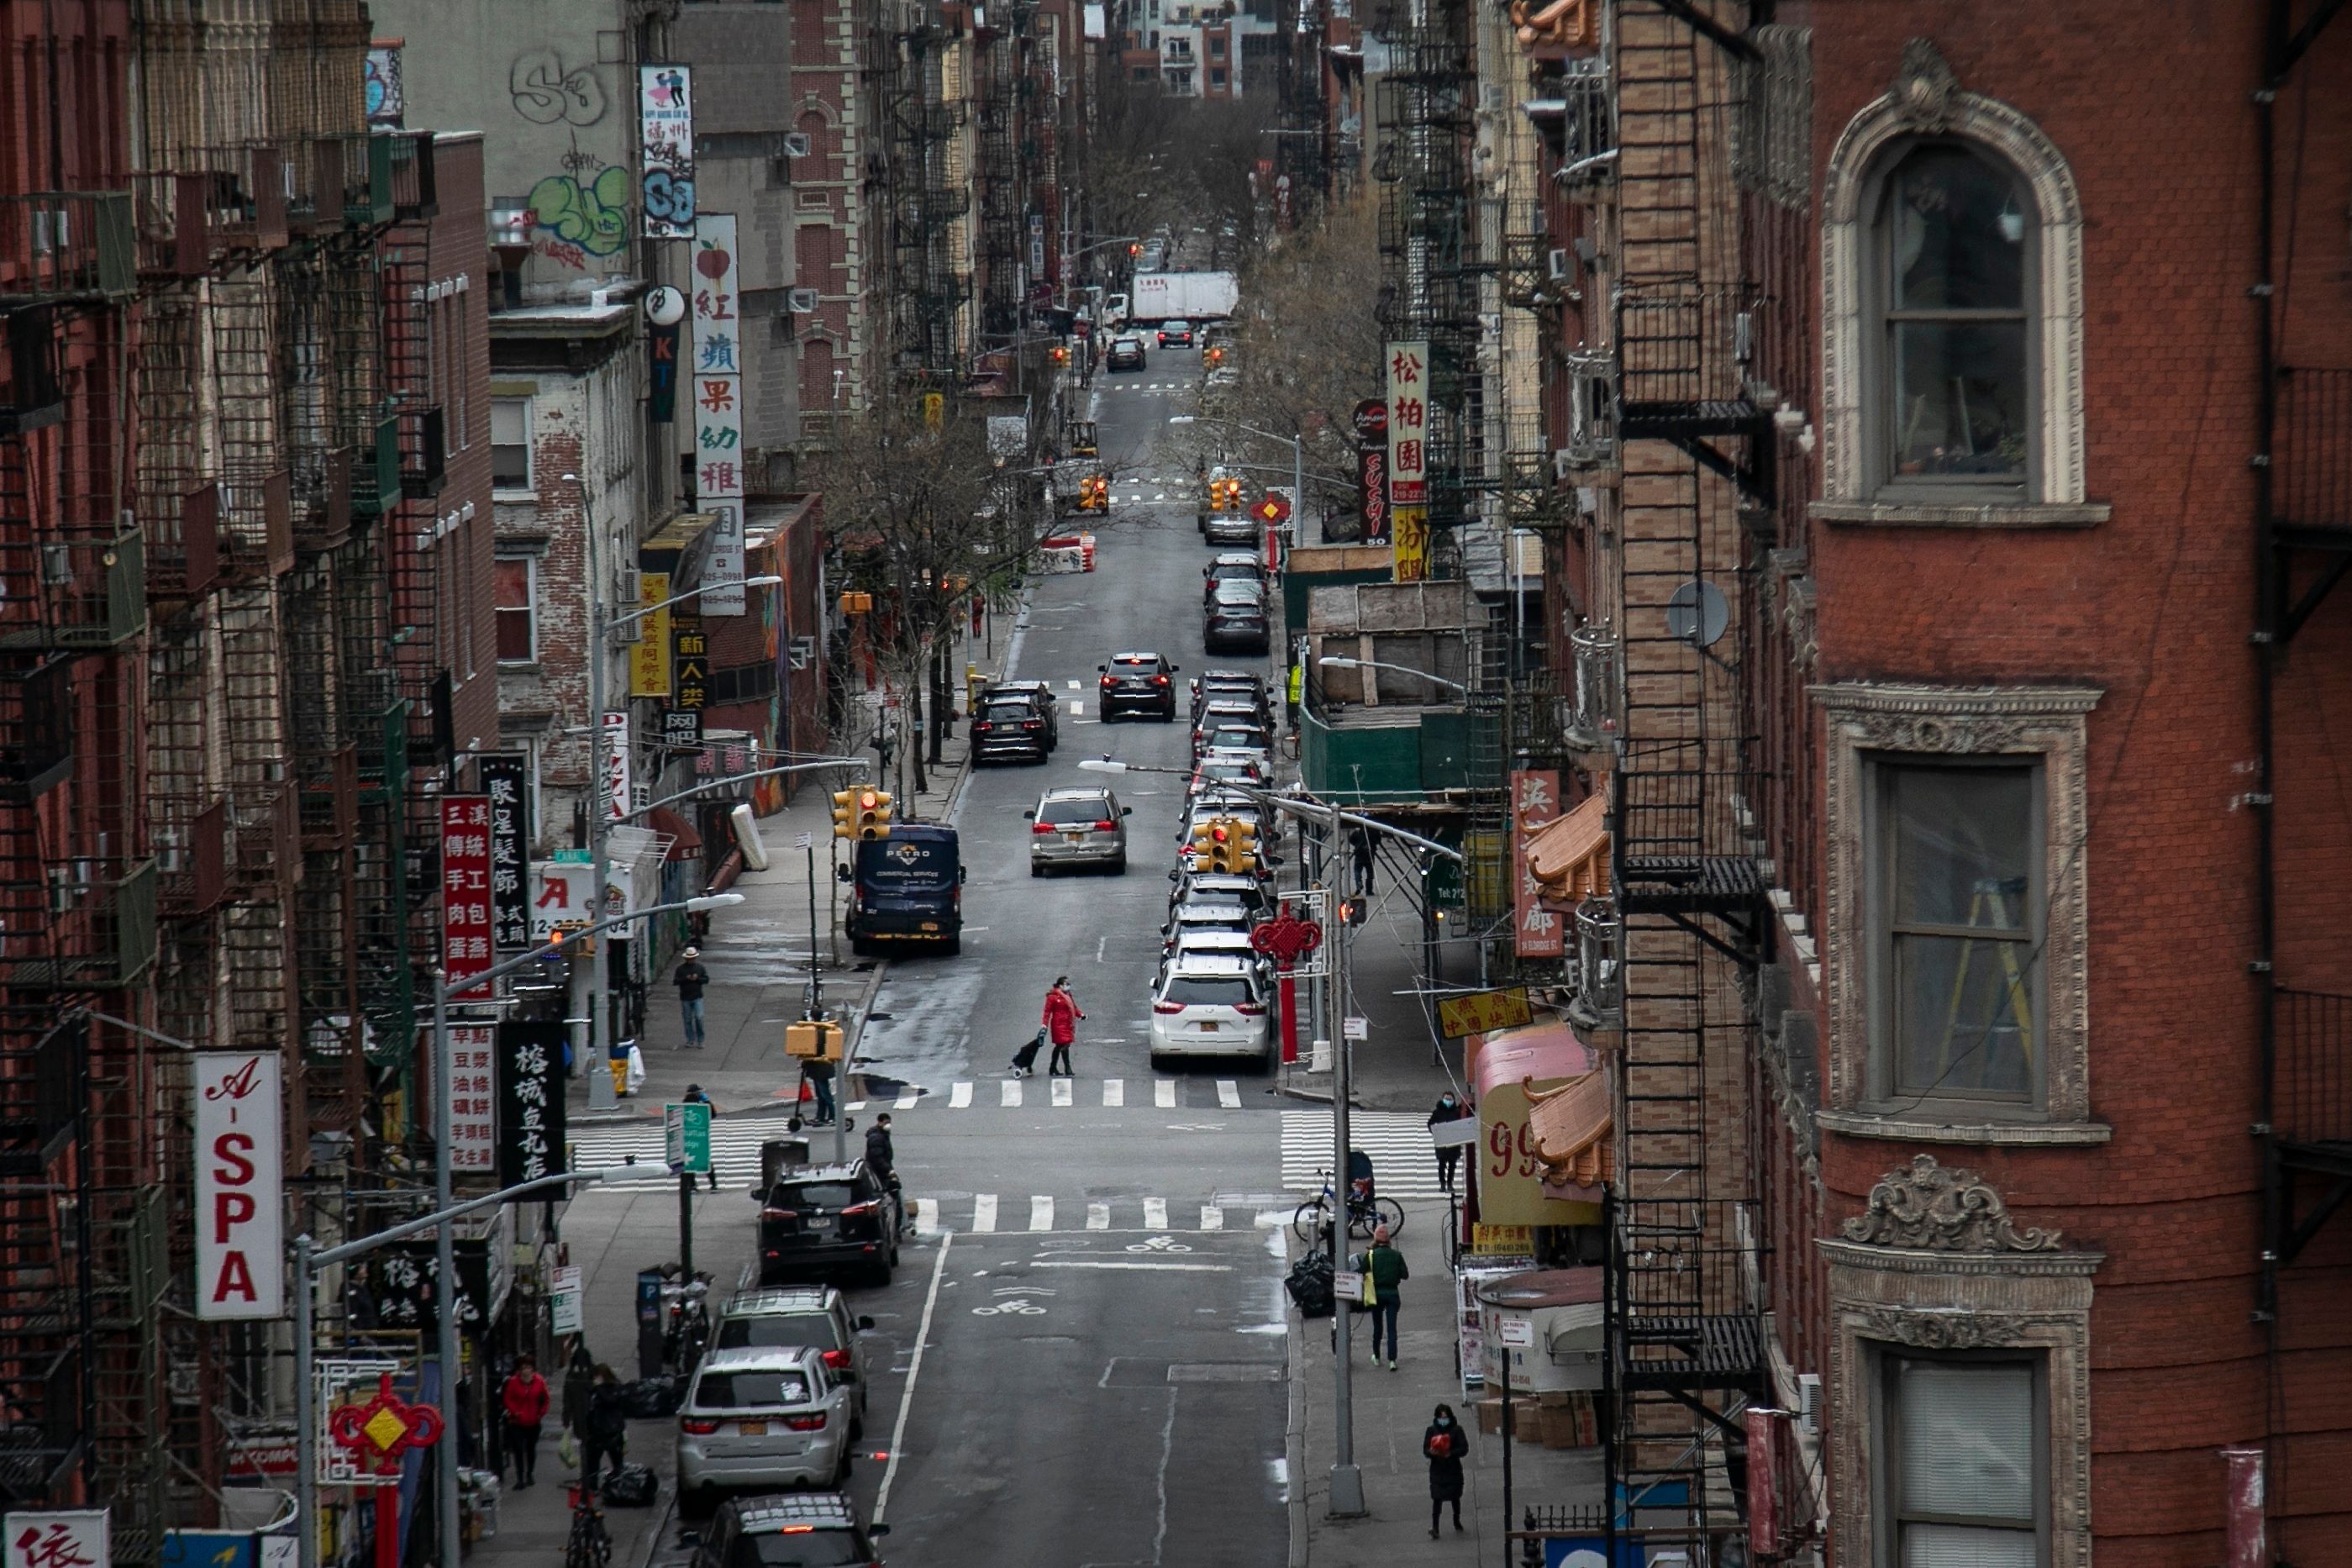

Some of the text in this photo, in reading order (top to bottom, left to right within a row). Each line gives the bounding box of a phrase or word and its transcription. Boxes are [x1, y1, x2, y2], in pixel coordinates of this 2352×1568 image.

[645, 120, 688, 141] 福州
[655, 337, 673, 418] KTV
[1392, 350, 1423, 473] 松柏園
[1365, 453, 1386, 535] SUSHI
[679, 636, 705, 708] 新人类
[666, 714, 697, 745] 网吧
[445, 835, 486, 857] 傳統
[446, 869, 486, 892] 手工
[447, 902, 487, 924] 肉包
[454, 1052, 490, 1068] 豆漿
[454, 1076, 490, 1092] 油條
